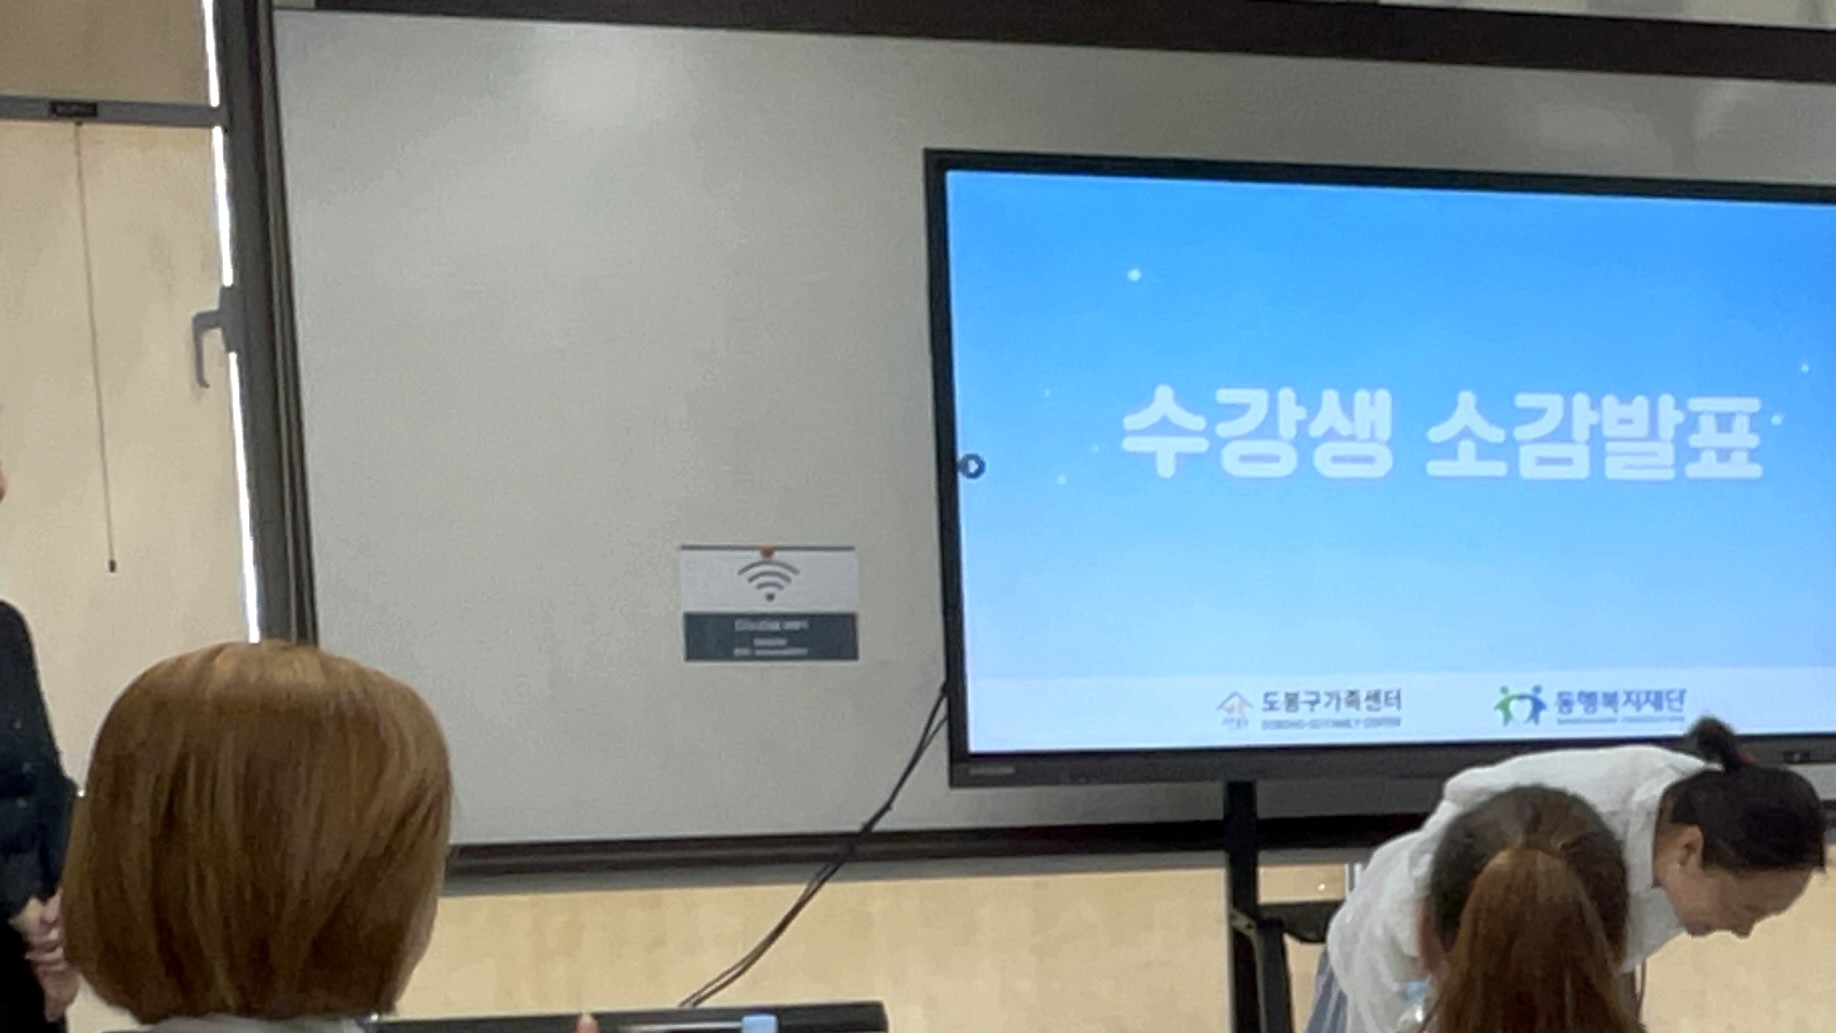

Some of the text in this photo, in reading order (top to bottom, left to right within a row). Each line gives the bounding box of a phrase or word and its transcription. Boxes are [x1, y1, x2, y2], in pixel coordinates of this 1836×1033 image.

[1121, 383, 1764, 481] 수강생 소감발표
[1261, 689, 1402, 713] 도봉구가족센터
[1556, 688, 1687, 715] 동행복지재단
